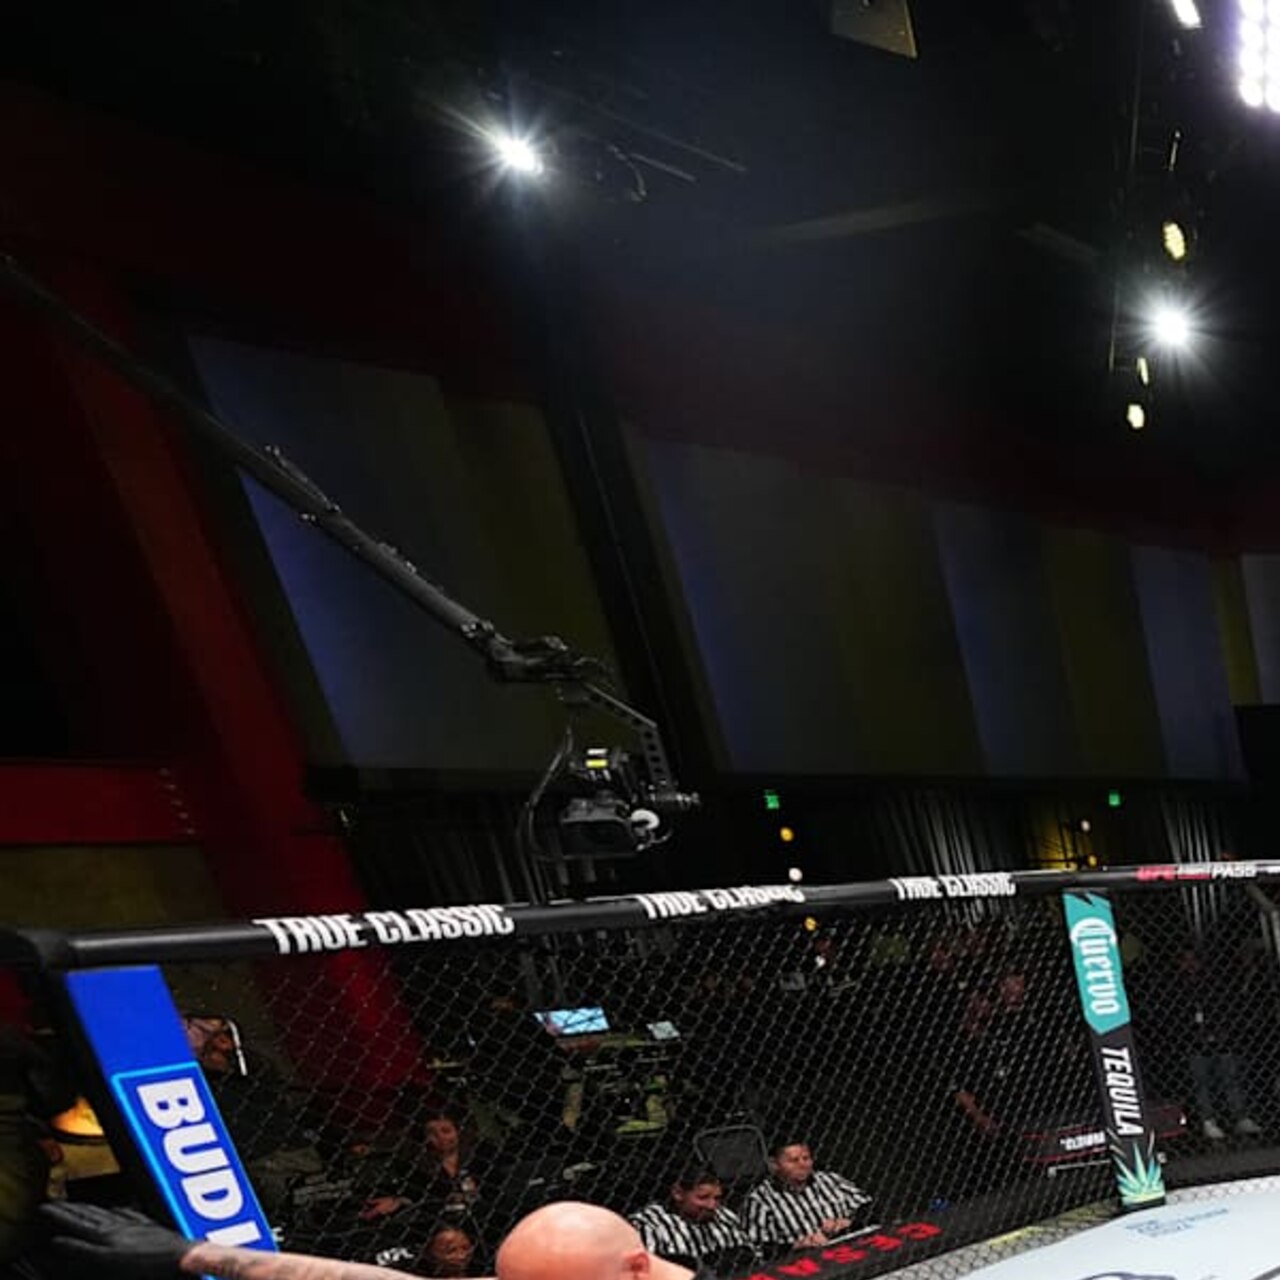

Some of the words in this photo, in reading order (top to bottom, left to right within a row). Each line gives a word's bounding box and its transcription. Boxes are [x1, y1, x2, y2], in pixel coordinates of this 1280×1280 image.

[1211, 861, 1257, 879] PASS
[251, 914, 367, 954] TRUE
[363, 904, 515, 944] CLASSIC
[1069, 916, 1121, 1016] Cuervo
[1100, 1046, 1145, 1136] TEQUILA
[136, 1077, 244, 1221] BUD
